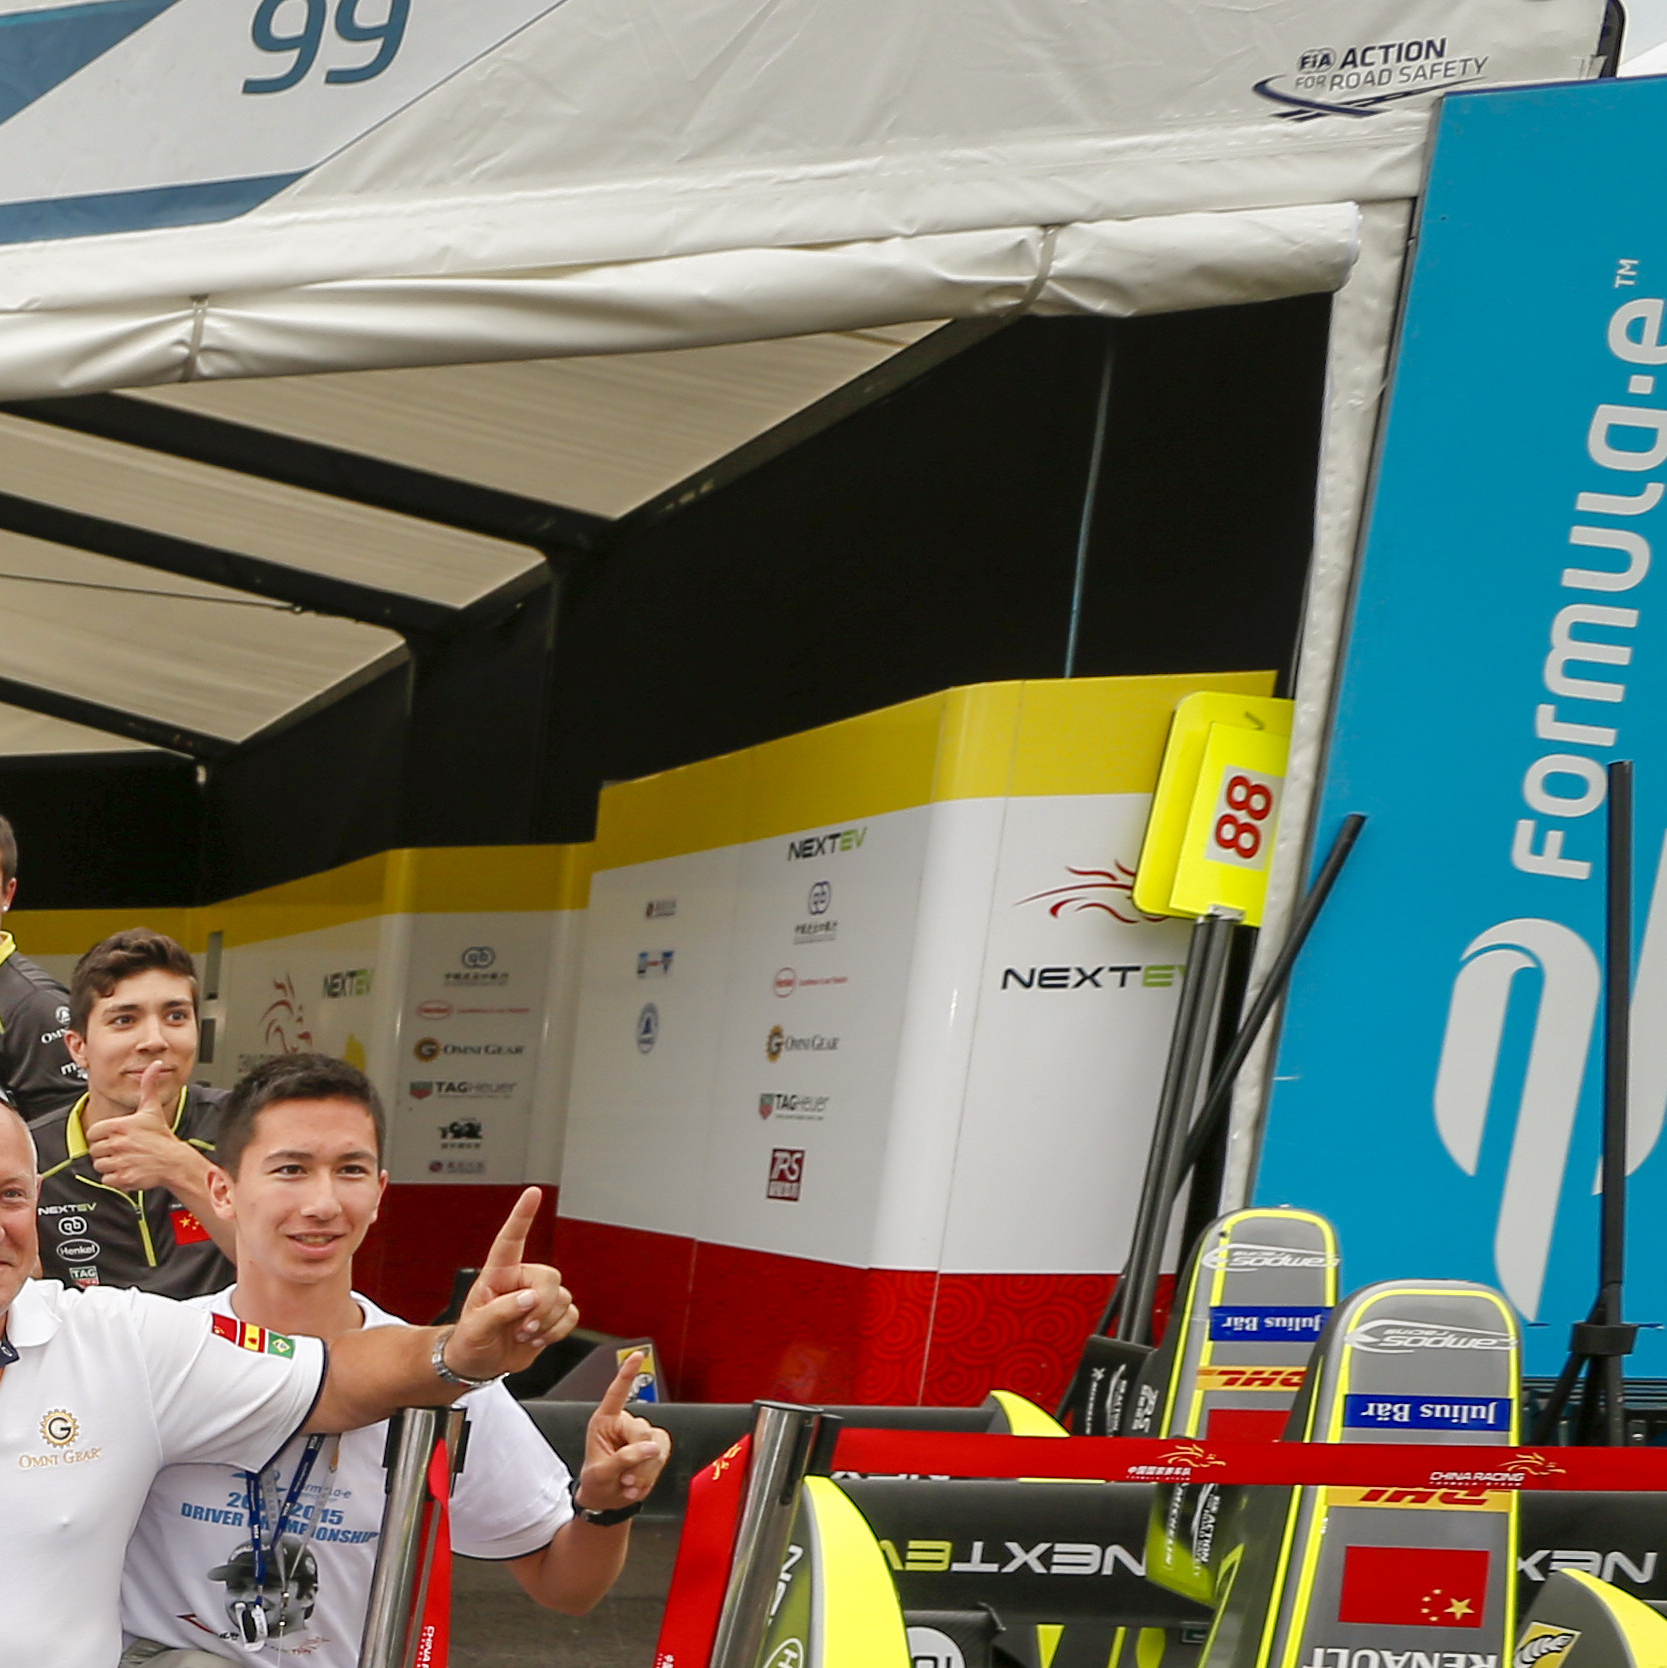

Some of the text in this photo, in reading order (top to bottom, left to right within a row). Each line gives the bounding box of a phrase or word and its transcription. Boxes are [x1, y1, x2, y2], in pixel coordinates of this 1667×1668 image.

[241, 0, 413, 95] 99
[1339, 37, 1448, 70] ACTION
[1294, 56, 1490, 92] FOR ROAD SAFETY
[1215, 774, 1274, 860] 88
[787, 826, 868, 861] NEXTEV
[38, 1203, 97, 1216] NEXTEV
[61, 1244, 96, 1256] Henkel
[1360, 1401, 1498, 1425] Julius Bär
[19, 1455, 59, 1470] OMNI
[1429, 1471, 1526, 1483] CHINA RACING
[181, 1502, 245, 1528] DRIVER
